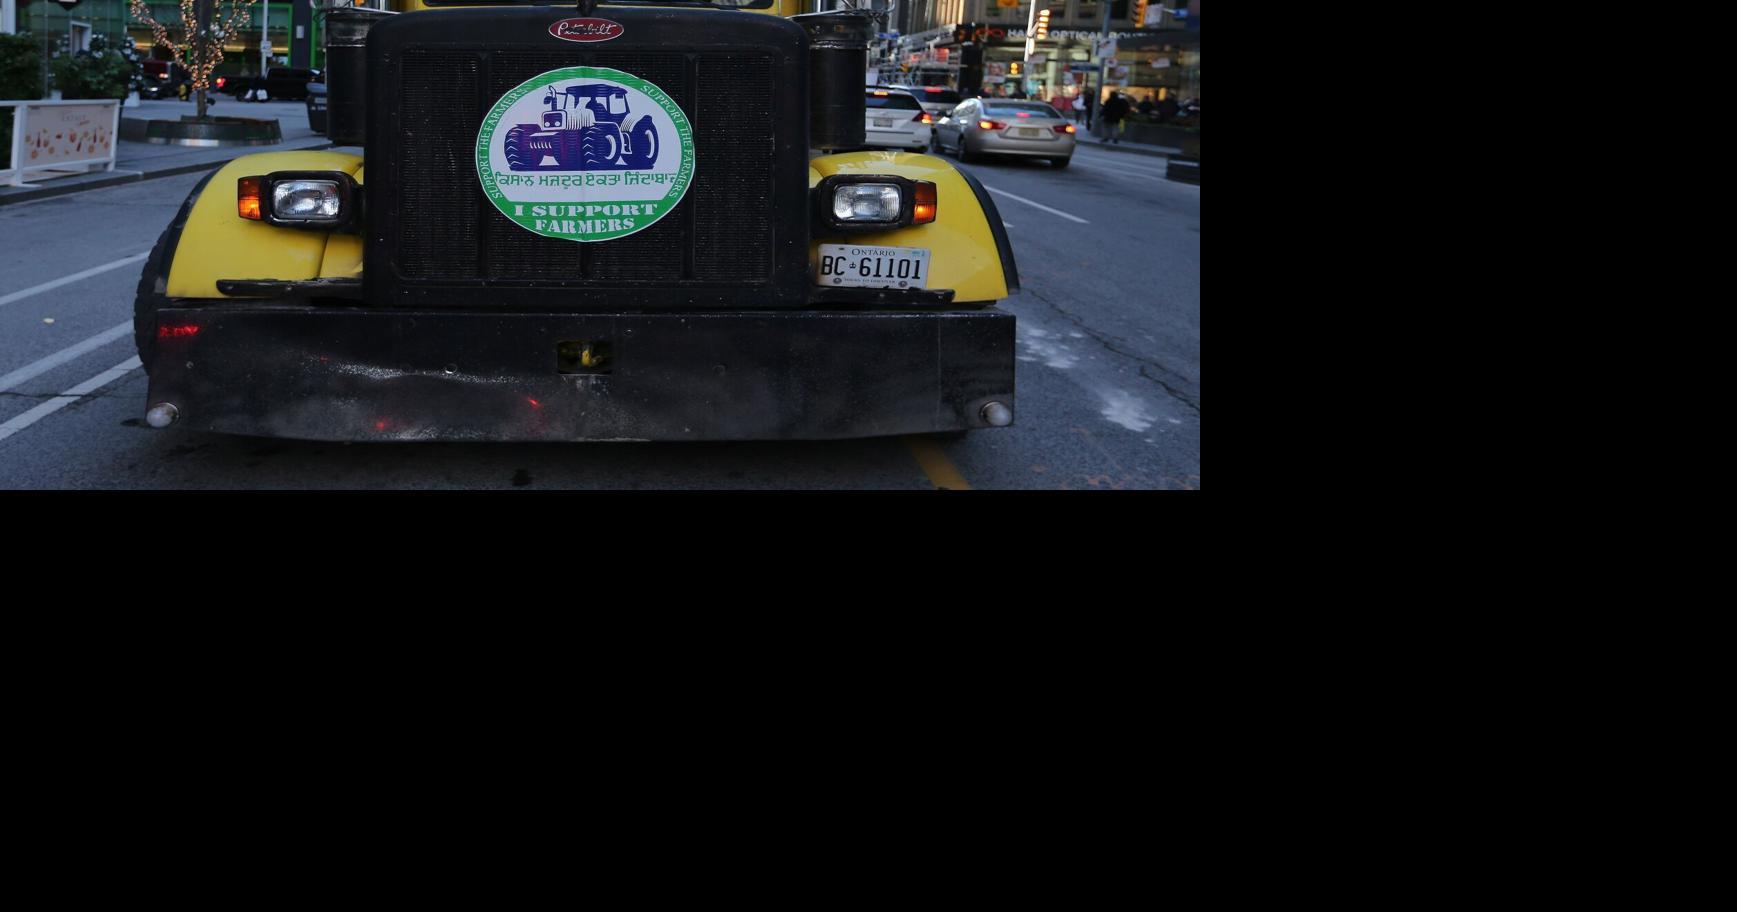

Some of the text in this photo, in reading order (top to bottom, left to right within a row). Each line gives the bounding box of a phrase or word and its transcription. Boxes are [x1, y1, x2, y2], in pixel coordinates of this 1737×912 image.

[558, 22, 617, 36] Ptbilt
[479, 88, 528, 199] SUPPORT THE FARMERS
[640, 85, 693, 197] SUPPORT THE FARMERS
[514, 203, 658, 217] I SUPPORT
[535, 218, 635, 234] FARMERS
[821, 255, 921, 280] BC 61101
